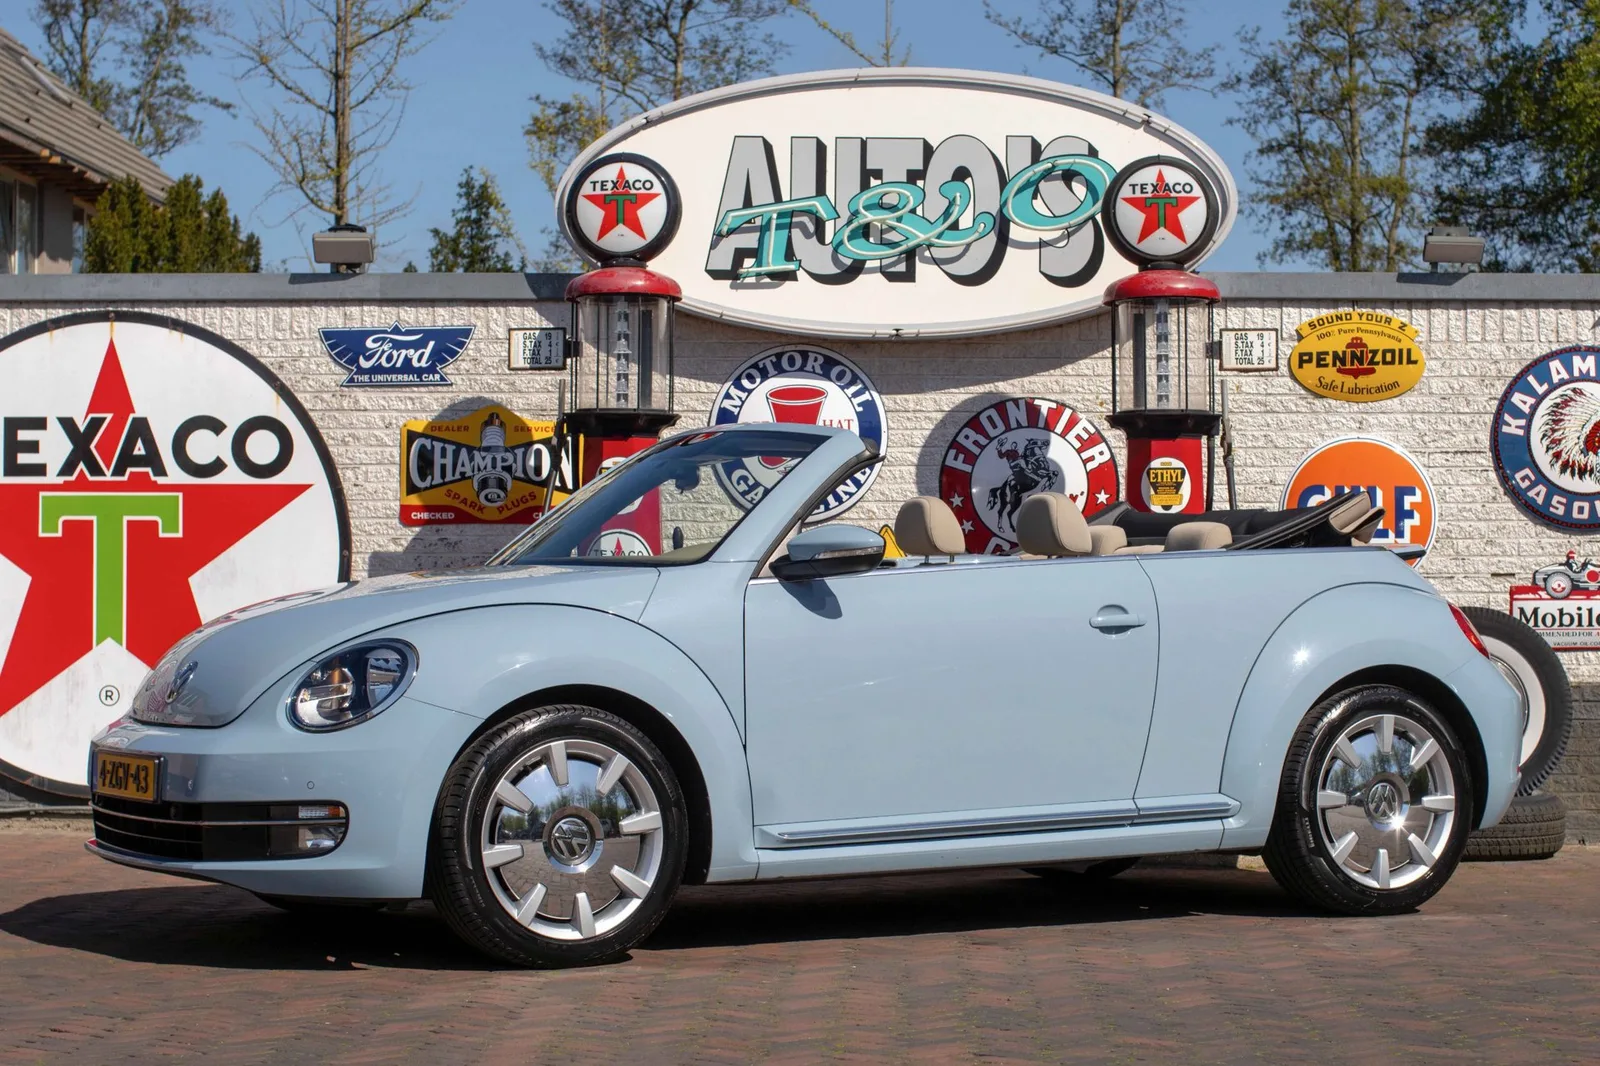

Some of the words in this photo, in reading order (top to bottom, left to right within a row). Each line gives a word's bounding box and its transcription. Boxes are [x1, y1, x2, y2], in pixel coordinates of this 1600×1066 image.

[590, 179, 654, 191] TEXACO
[1129, 183, 1193, 194] TEXACO
[1307, 312, 1353, 331] SOUND
[1357, 312, 1393, 326] YOUR
[523, 332, 536, 340] GAS
[1316, 330, 1336, 341] 100%
[1338, 327, 1355, 335] Pure
[1356, 327, 1402, 343] Pennsylvania
[359, 333, 435, 368] Ford
[1298, 348, 1419, 369] PENNZOIL
[721, 351, 825, 415] MOTOR
[830, 364, 873, 413] OIL
[1315, 376, 1339, 393] Safe
[1340, 381, 1400, 395] Lubrication
[431, 425, 469, 433] DEALER
[945, 398, 1111, 473] FRONTIER
[410, 437, 573, 490] CHAMPION
[1150, 469, 1184, 482] ETHYL
[444, 489, 486, 514] SPARK
[496, 492, 537, 513] PLUGS
[99, 759, 148, 794] 4-ZGV-43
